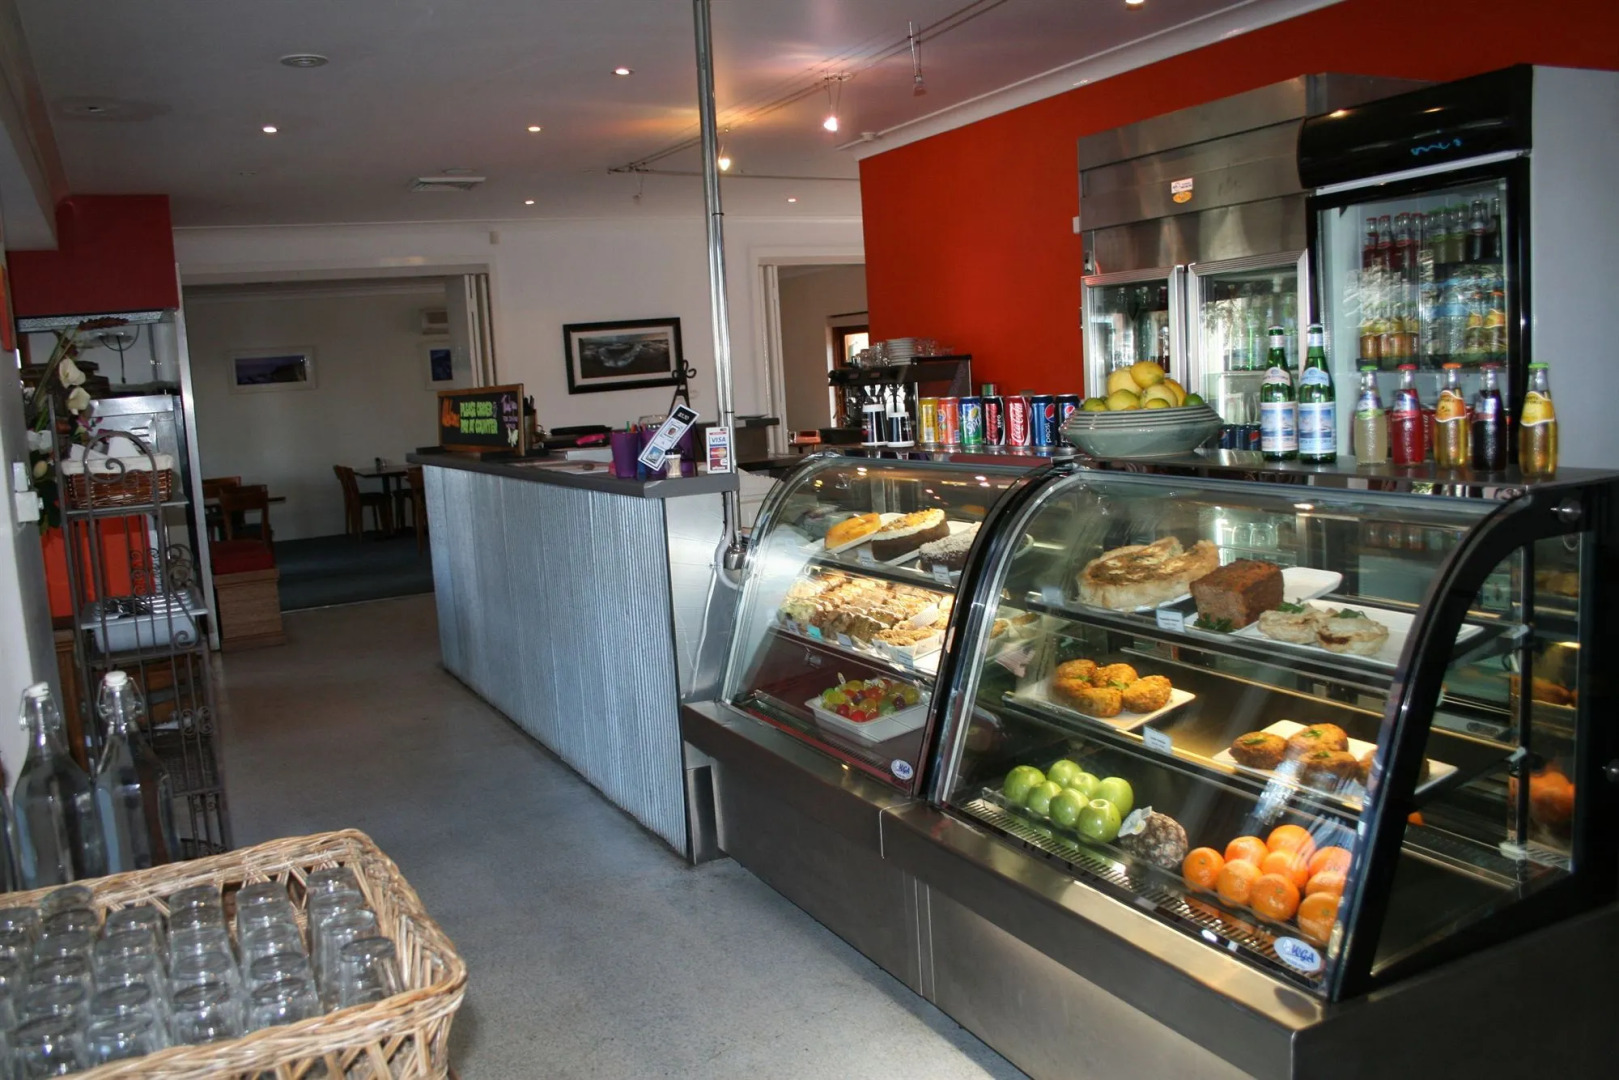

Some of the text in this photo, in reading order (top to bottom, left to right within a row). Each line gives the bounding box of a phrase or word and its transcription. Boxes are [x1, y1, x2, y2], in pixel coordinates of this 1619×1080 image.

[1009, 402, 1025, 443] Coca-Cola
[1044, 422, 1052, 443] pepsi
[711, 435, 726, 443] VISA
